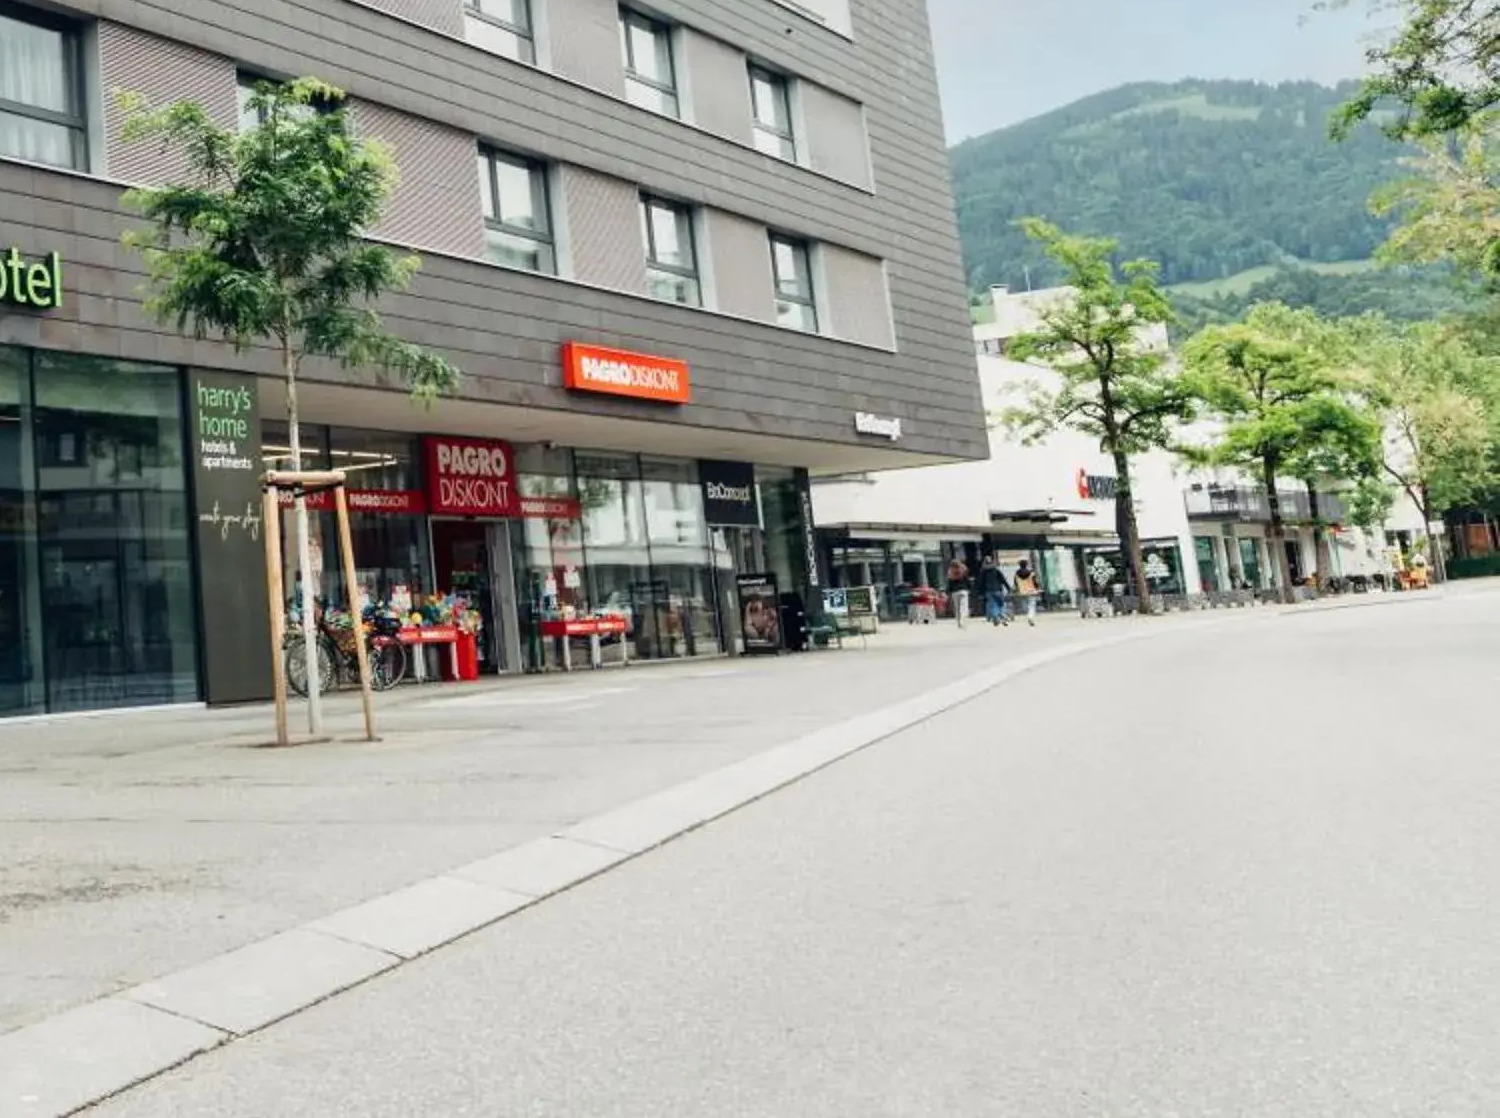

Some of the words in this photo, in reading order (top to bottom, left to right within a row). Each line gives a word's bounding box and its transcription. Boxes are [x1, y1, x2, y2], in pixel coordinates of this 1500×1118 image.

[197, 379, 252, 415] harry's
[200, 409, 248, 438] home
[202, 456, 253, 471] apartments
[437, 443, 507, 477] PAGRO
[440, 477, 509, 508] DISKONT
